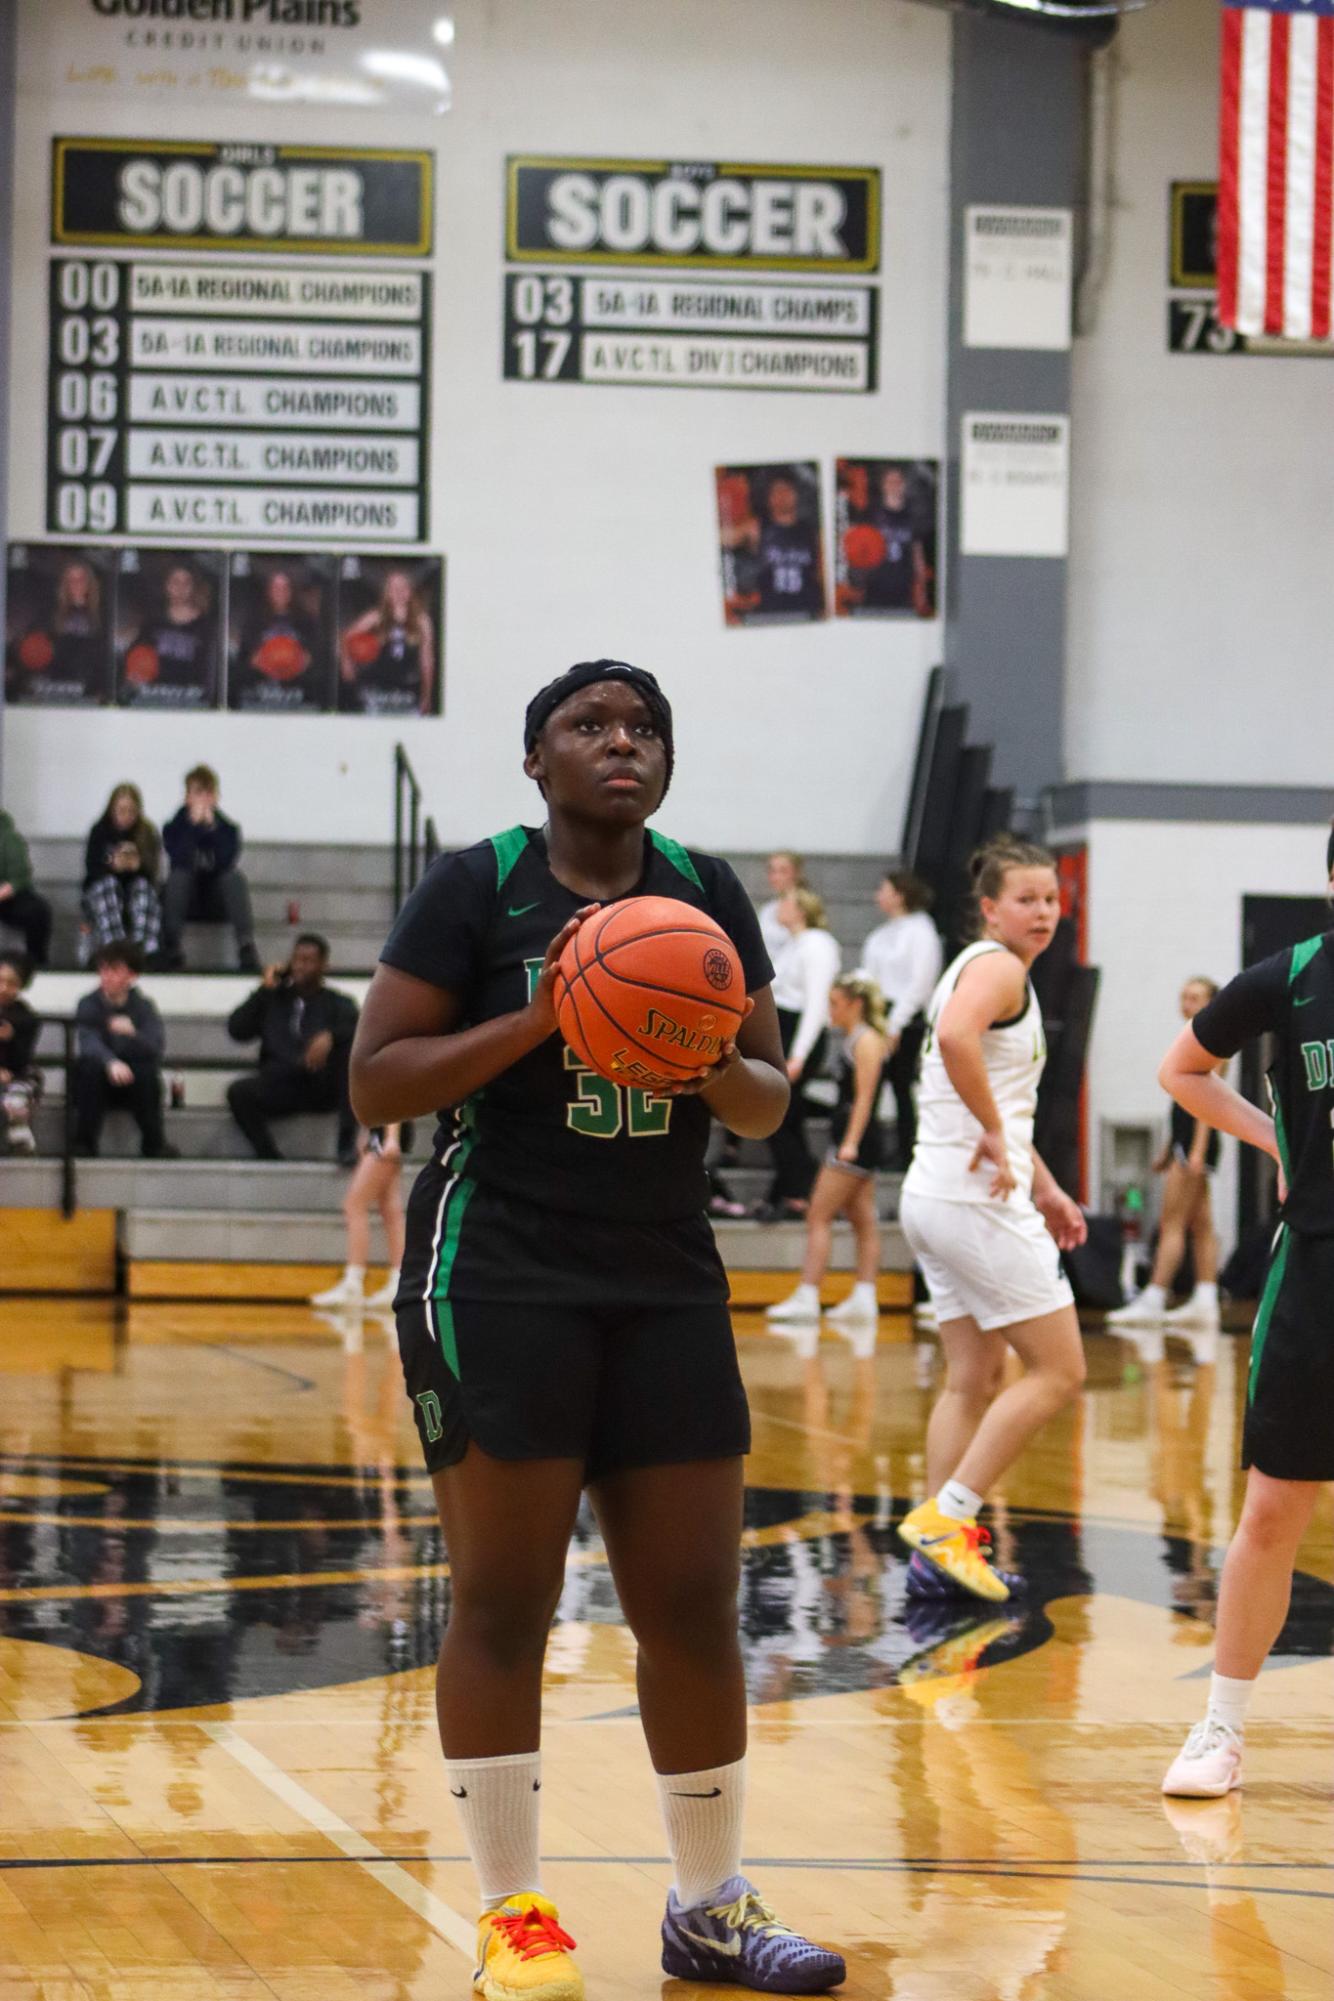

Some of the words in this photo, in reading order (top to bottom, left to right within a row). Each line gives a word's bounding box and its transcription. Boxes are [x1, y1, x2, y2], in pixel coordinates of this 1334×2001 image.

[125, 31, 224, 50] CREDIT
[237, 35, 326, 55] UNION
[118, 158, 364, 239] SOCCER
[547, 172, 848, 258] SOCCER
[60, 261, 120, 312] 00
[196, 276, 291, 302] REGIONAL
[301, 280, 417, 307] CHAMPIONS
[513, 275, 574, 327] 03
[672, 294, 763, 320] REGIONAL
[773, 295, 860, 325] CHAMPS
[59, 314, 120, 367] 03
[213, 333, 300, 359] REGIONAL
[308, 336, 415, 364] CHAMPIONS
[514, 330, 572, 380] 17
[740, 350, 860, 380] CHAMPIONS
[57, 370, 119, 423] 06
[265, 388, 399, 419] CHAMPIONS
[57, 425, 119, 478] 07
[263, 444, 399, 475] CHAMPIONS
[263, 498, 399, 529] CHAMPIONS
[415, 1388, 444, 1443] D
